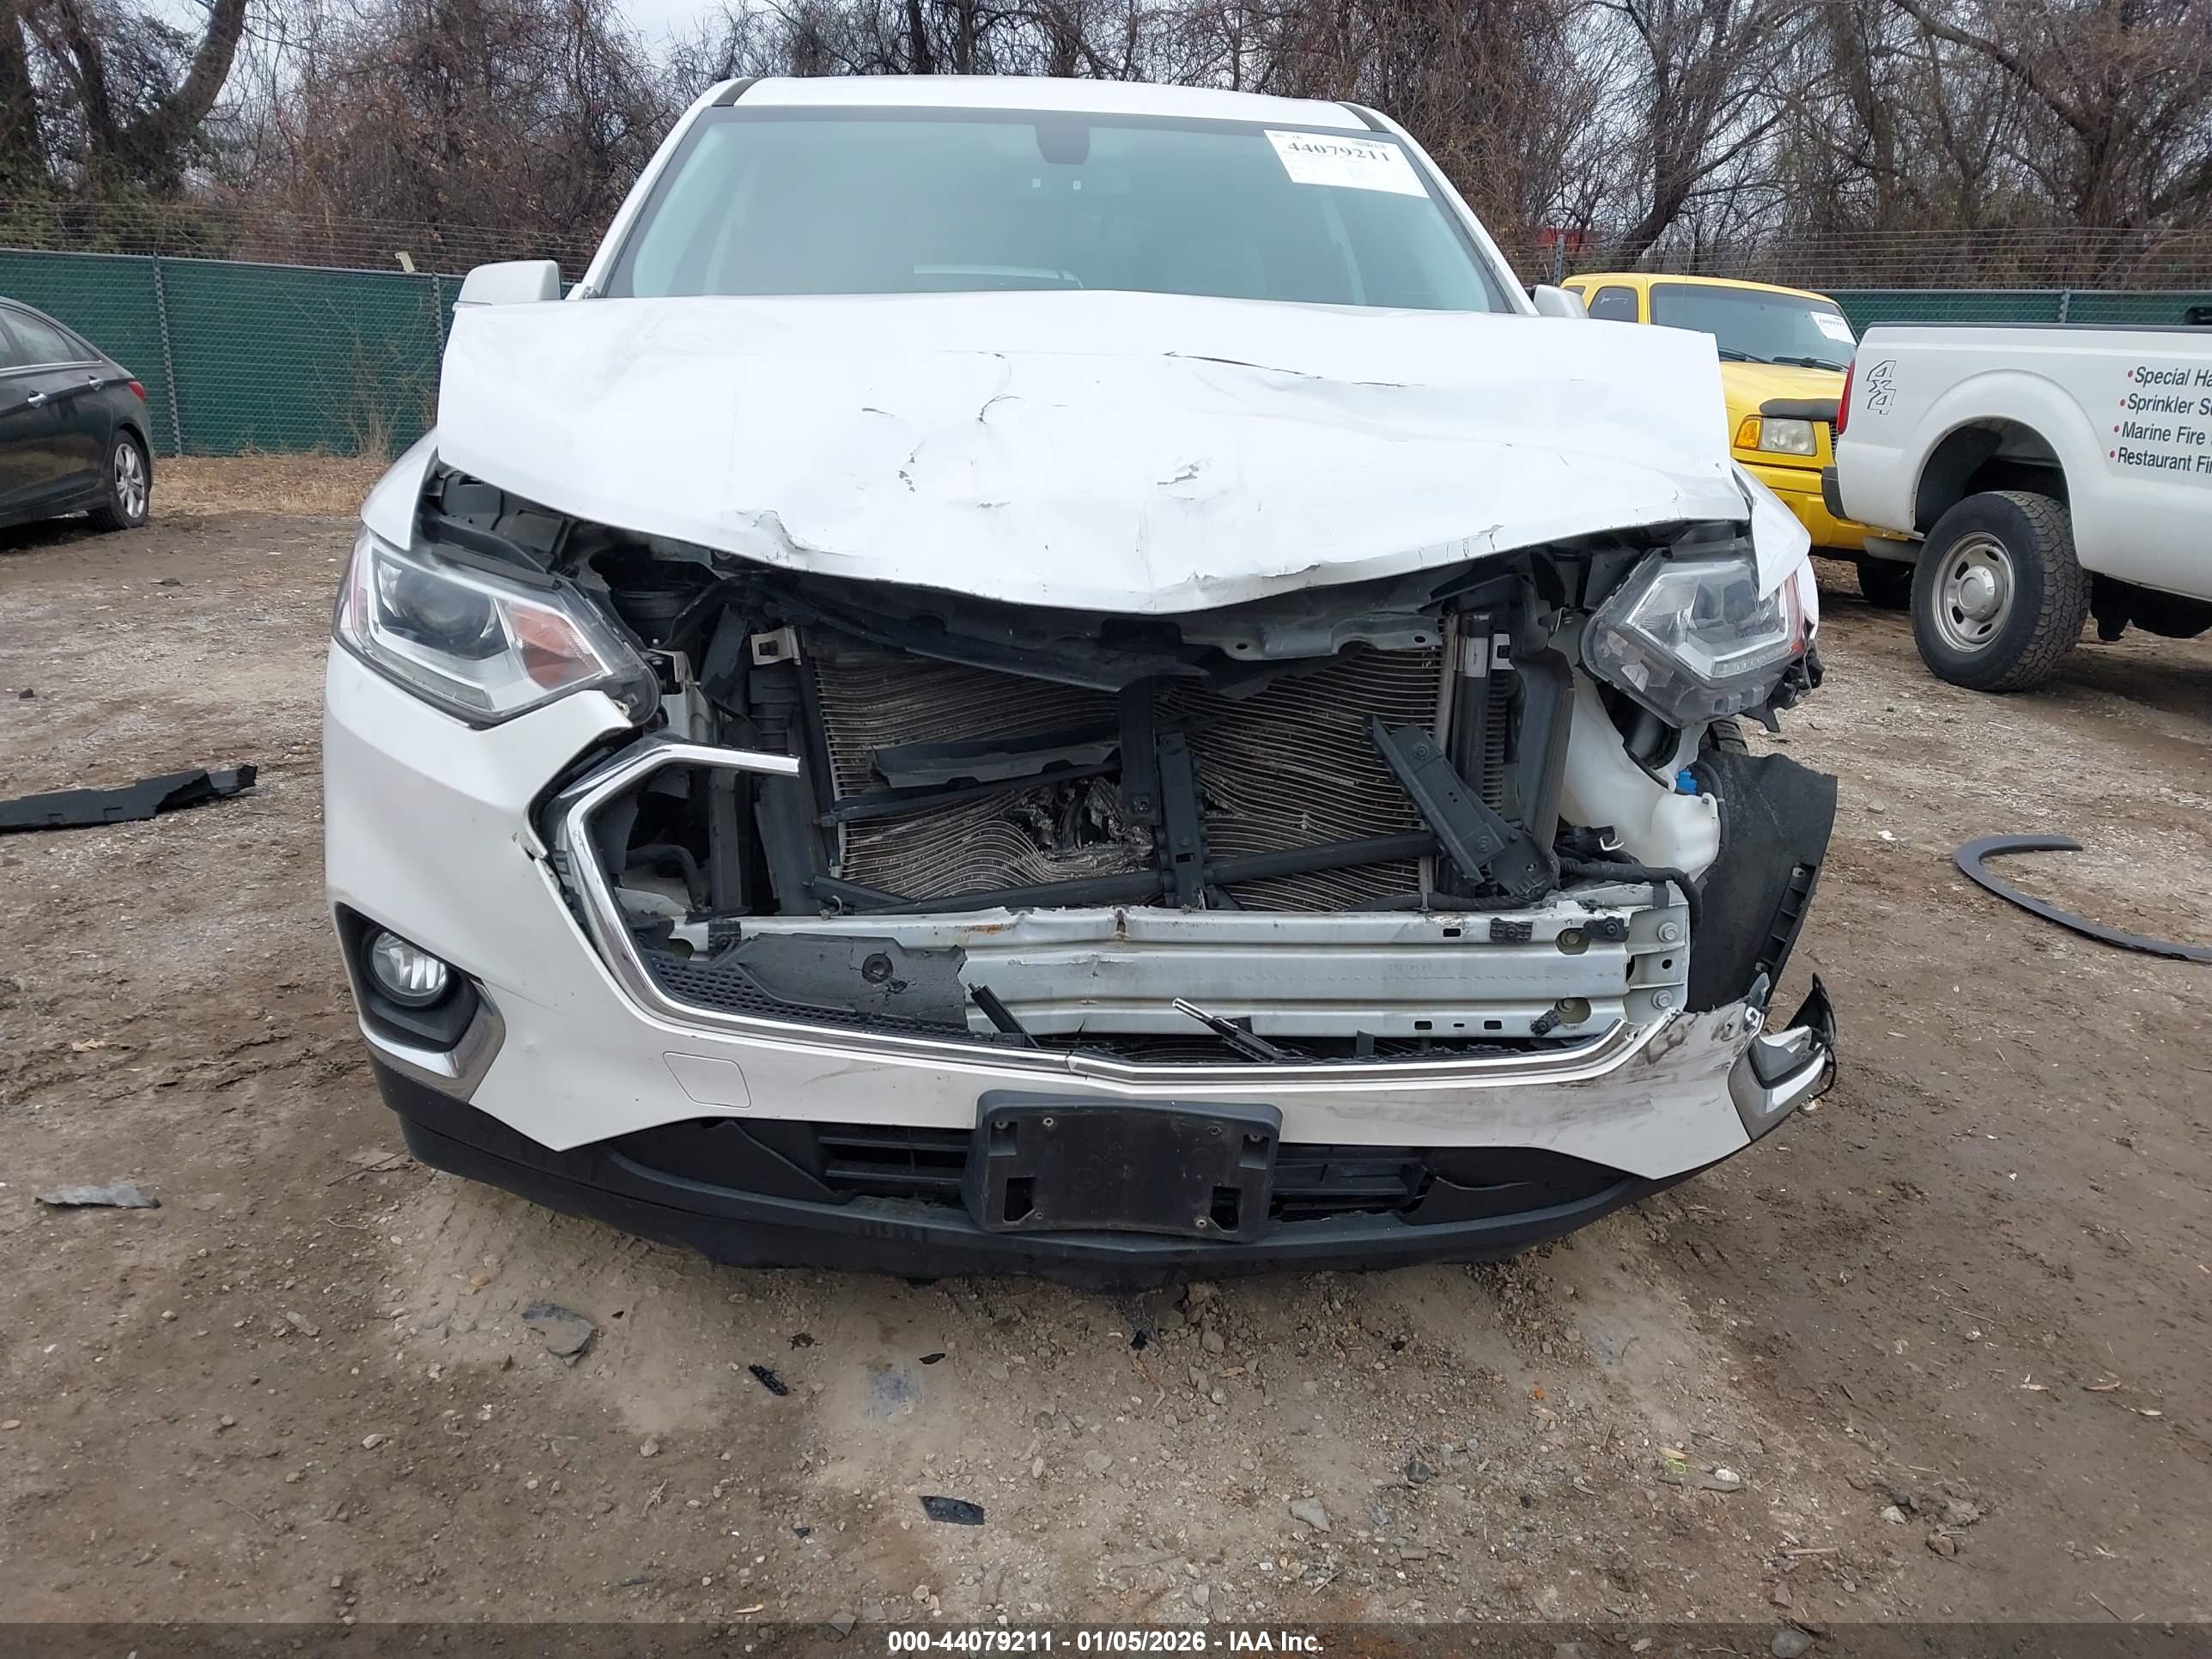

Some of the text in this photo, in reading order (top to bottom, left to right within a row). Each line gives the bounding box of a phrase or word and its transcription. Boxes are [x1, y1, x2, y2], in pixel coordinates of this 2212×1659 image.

[1288, 142, 1390, 162] 44079211
[2135, 366, 2191, 388] Special
[2127, 392, 2212, 416] Sprinkler S
[2122, 421, 2172, 442] Marine
[2176, 426, 2206, 446] Fire
[2118, 447, 2192, 471] Restaurant
